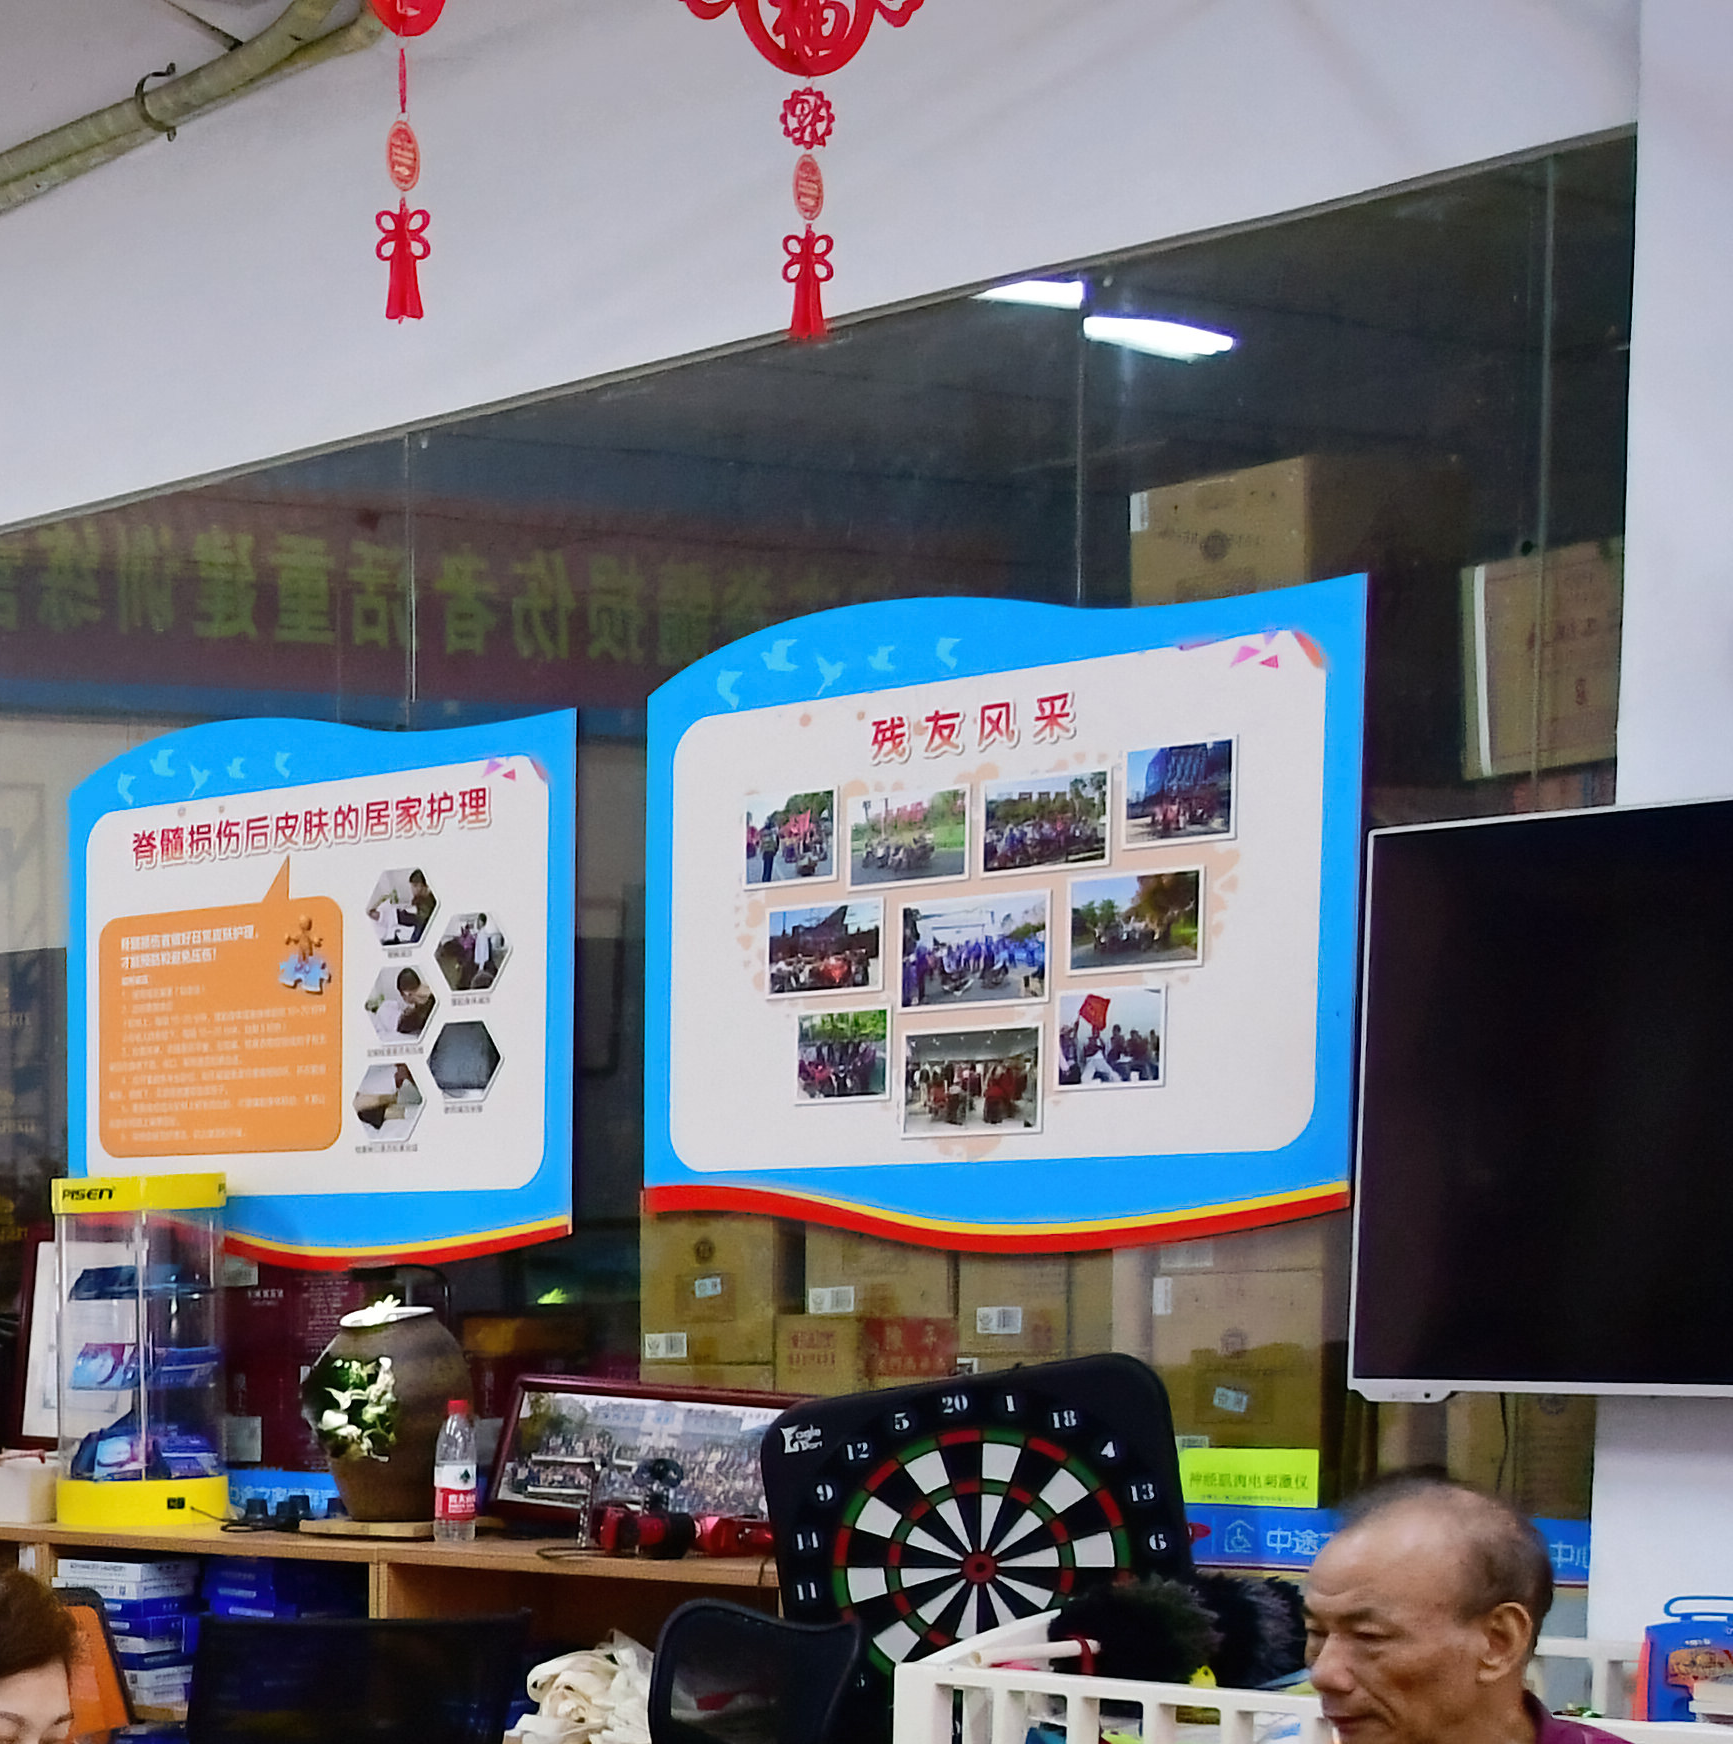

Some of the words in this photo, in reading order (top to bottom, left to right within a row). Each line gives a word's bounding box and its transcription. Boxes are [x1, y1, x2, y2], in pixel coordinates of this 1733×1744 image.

[868, 692, 1077, 764] 残友风采
[132, 784, 493, 869] 脊髓损伤后皮肤的居家护理
[941, 1394, 968, 1414] 20
[1006, 1394, 1017, 1412] 1
[894, 1412, 910, 1431] 5
[1051, 1410, 1078, 1428] 18
[847, 1442, 870, 1460] 12
[1101, 1440, 1116, 1458] 4
[816, 1484, 834, 1502] 9
[1130, 1483, 1155, 1502] 13
[796, 1532, 818, 1551] 14
[1149, 1533, 1167, 1551] 6
[796, 1582, 818, 1600] 11
